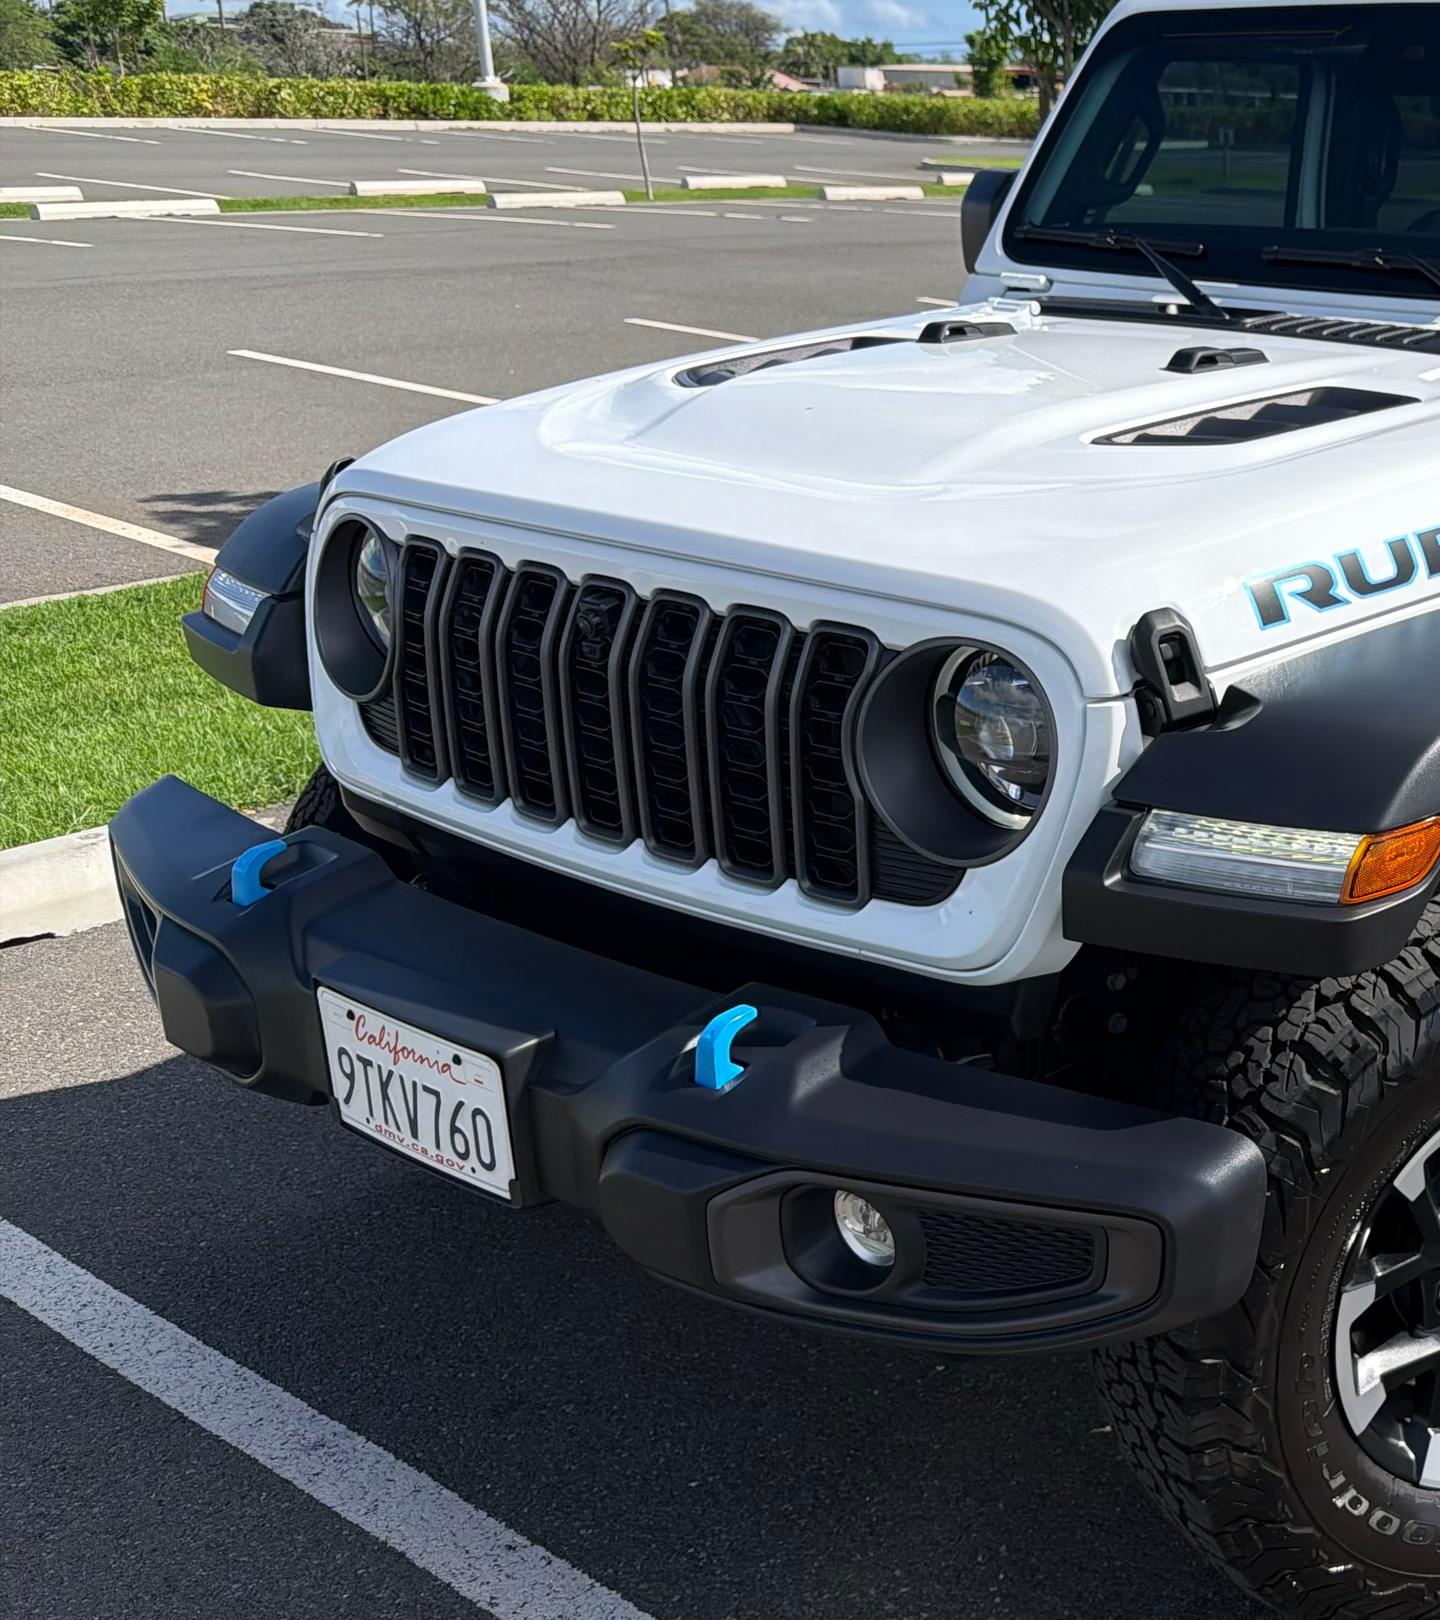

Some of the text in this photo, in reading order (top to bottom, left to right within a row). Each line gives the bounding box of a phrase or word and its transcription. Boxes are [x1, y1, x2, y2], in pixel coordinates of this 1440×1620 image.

[355, 1014, 467, 1085] California
[337, 1046, 497, 1172] 9TKV760
[374, 1122, 466, 1171] dmv.ca.gov
